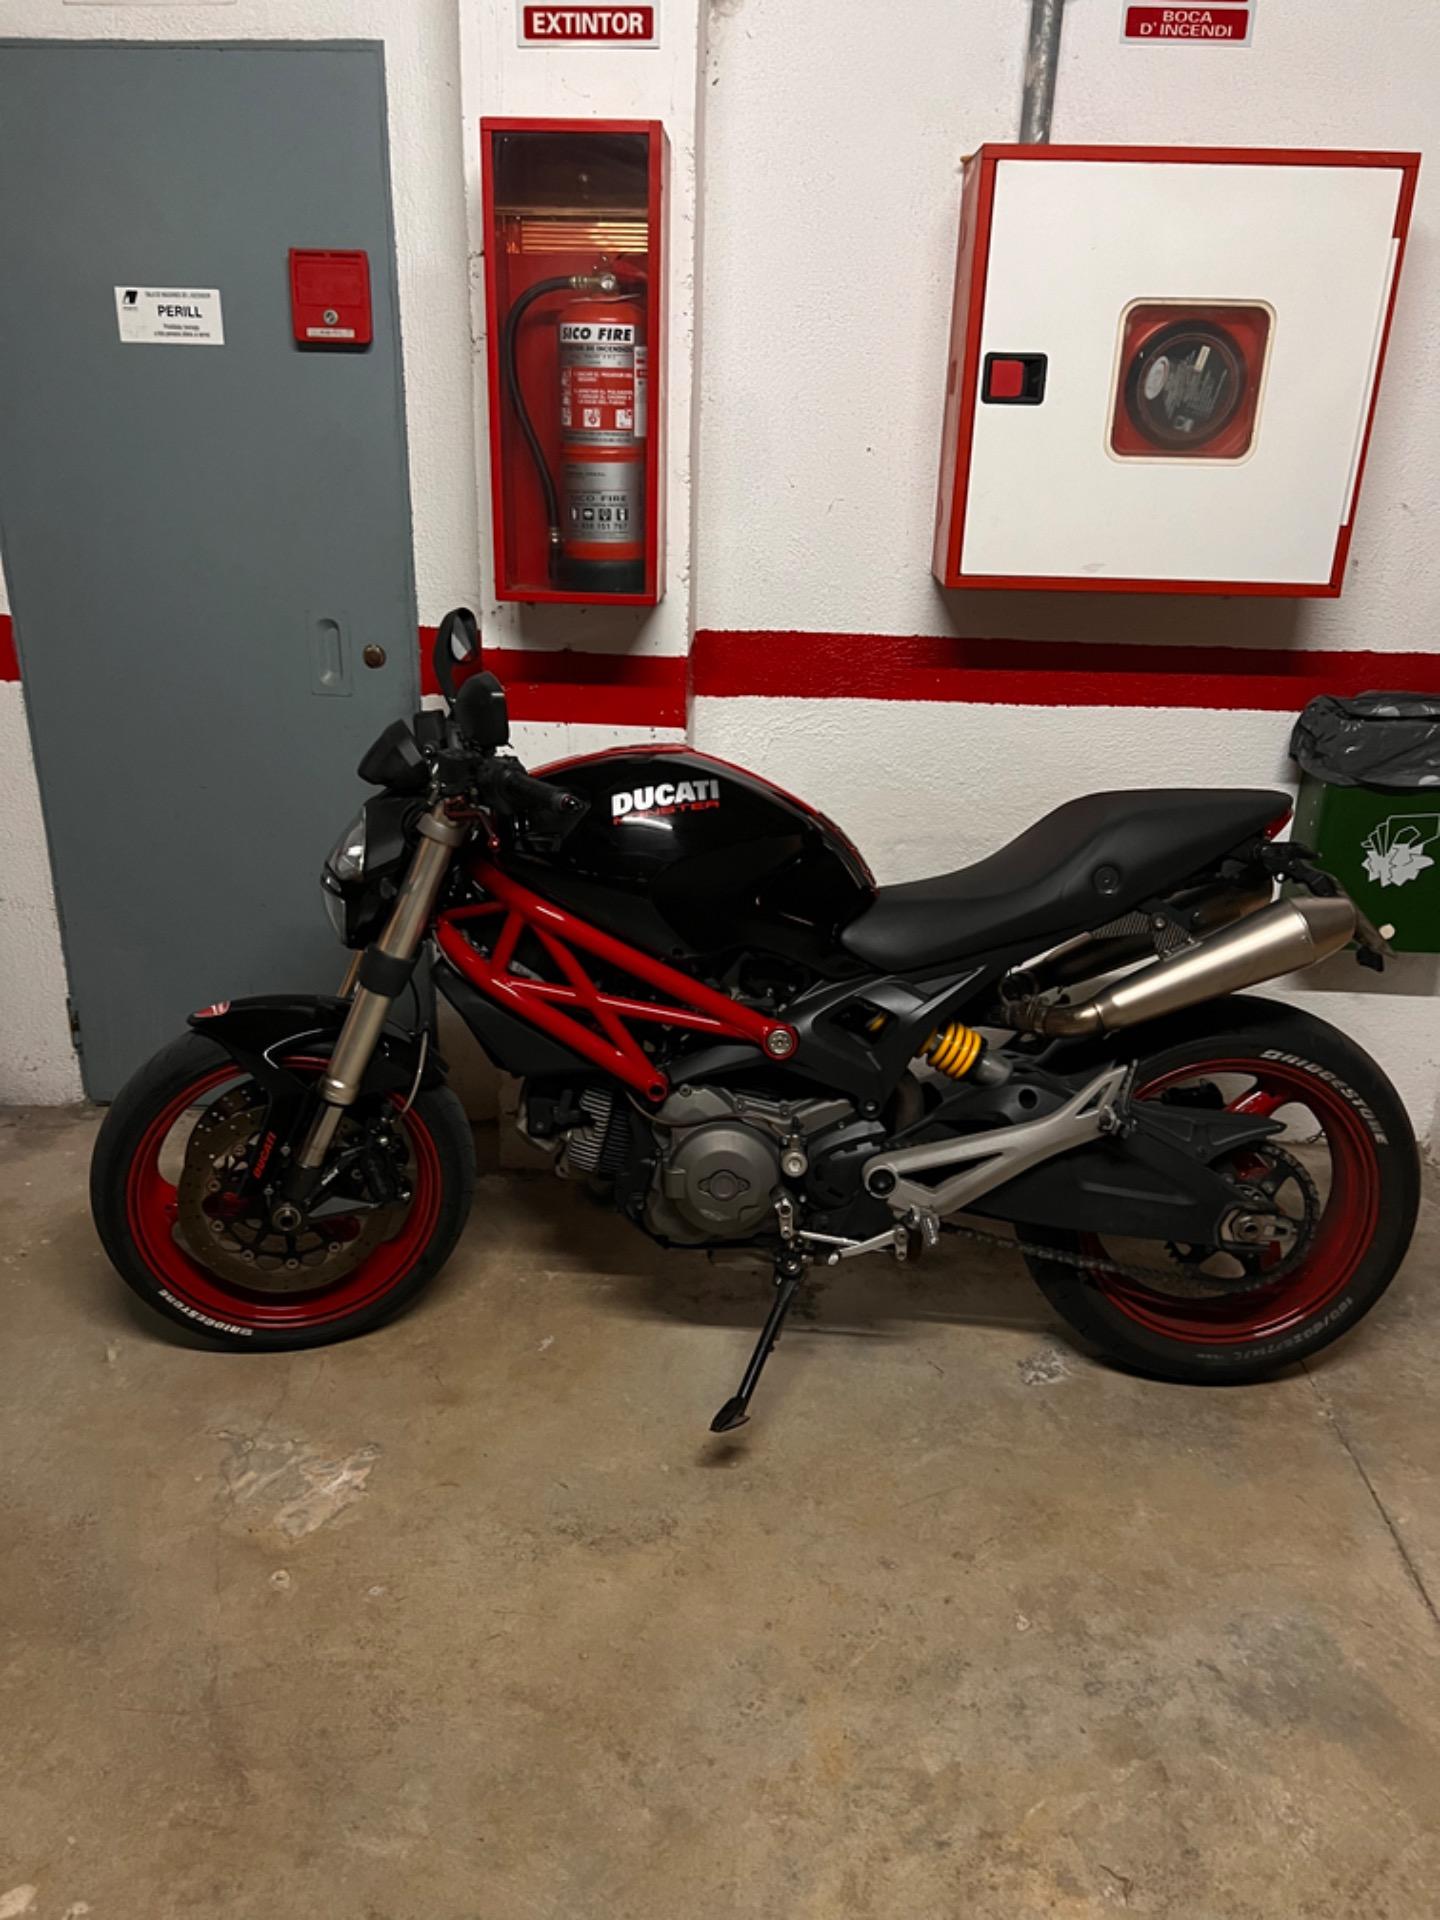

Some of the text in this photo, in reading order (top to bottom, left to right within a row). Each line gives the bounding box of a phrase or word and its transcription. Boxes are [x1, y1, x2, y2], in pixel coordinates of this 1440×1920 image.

[532, 12, 644, 35] EXTINTOR
[1162, 10, 1213, 24] BOCA
[1159, 23, 1233, 37] INCENDI
[157, 304, 203, 319] PERILL
[562, 327, 633, 341] SICO FIRE
[611, 779, 720, 817] DUCATI
[1259, 1049, 1390, 1145] BRIDGESTONE
